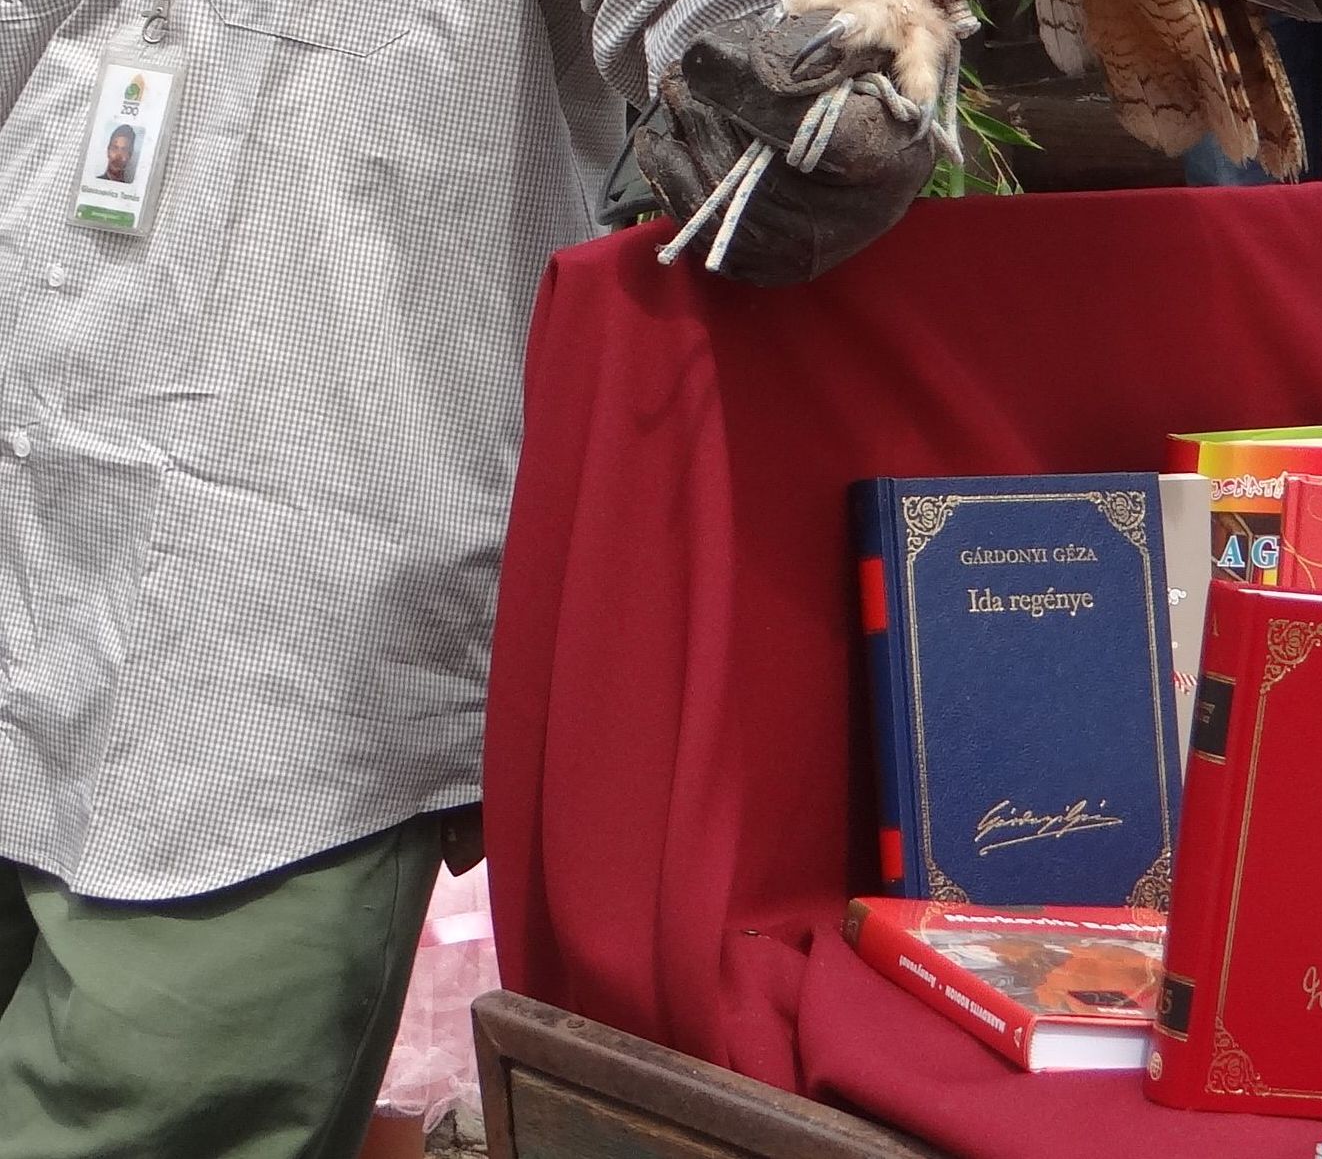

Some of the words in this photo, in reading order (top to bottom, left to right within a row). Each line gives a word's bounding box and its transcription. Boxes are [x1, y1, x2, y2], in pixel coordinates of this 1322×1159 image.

[961, 546, 1048, 564] GÁRDONYI
[1053, 544, 1098, 563] GÉZA
[968, 587, 1005, 613] Ida
[1009, 587, 1094, 617] regénye
